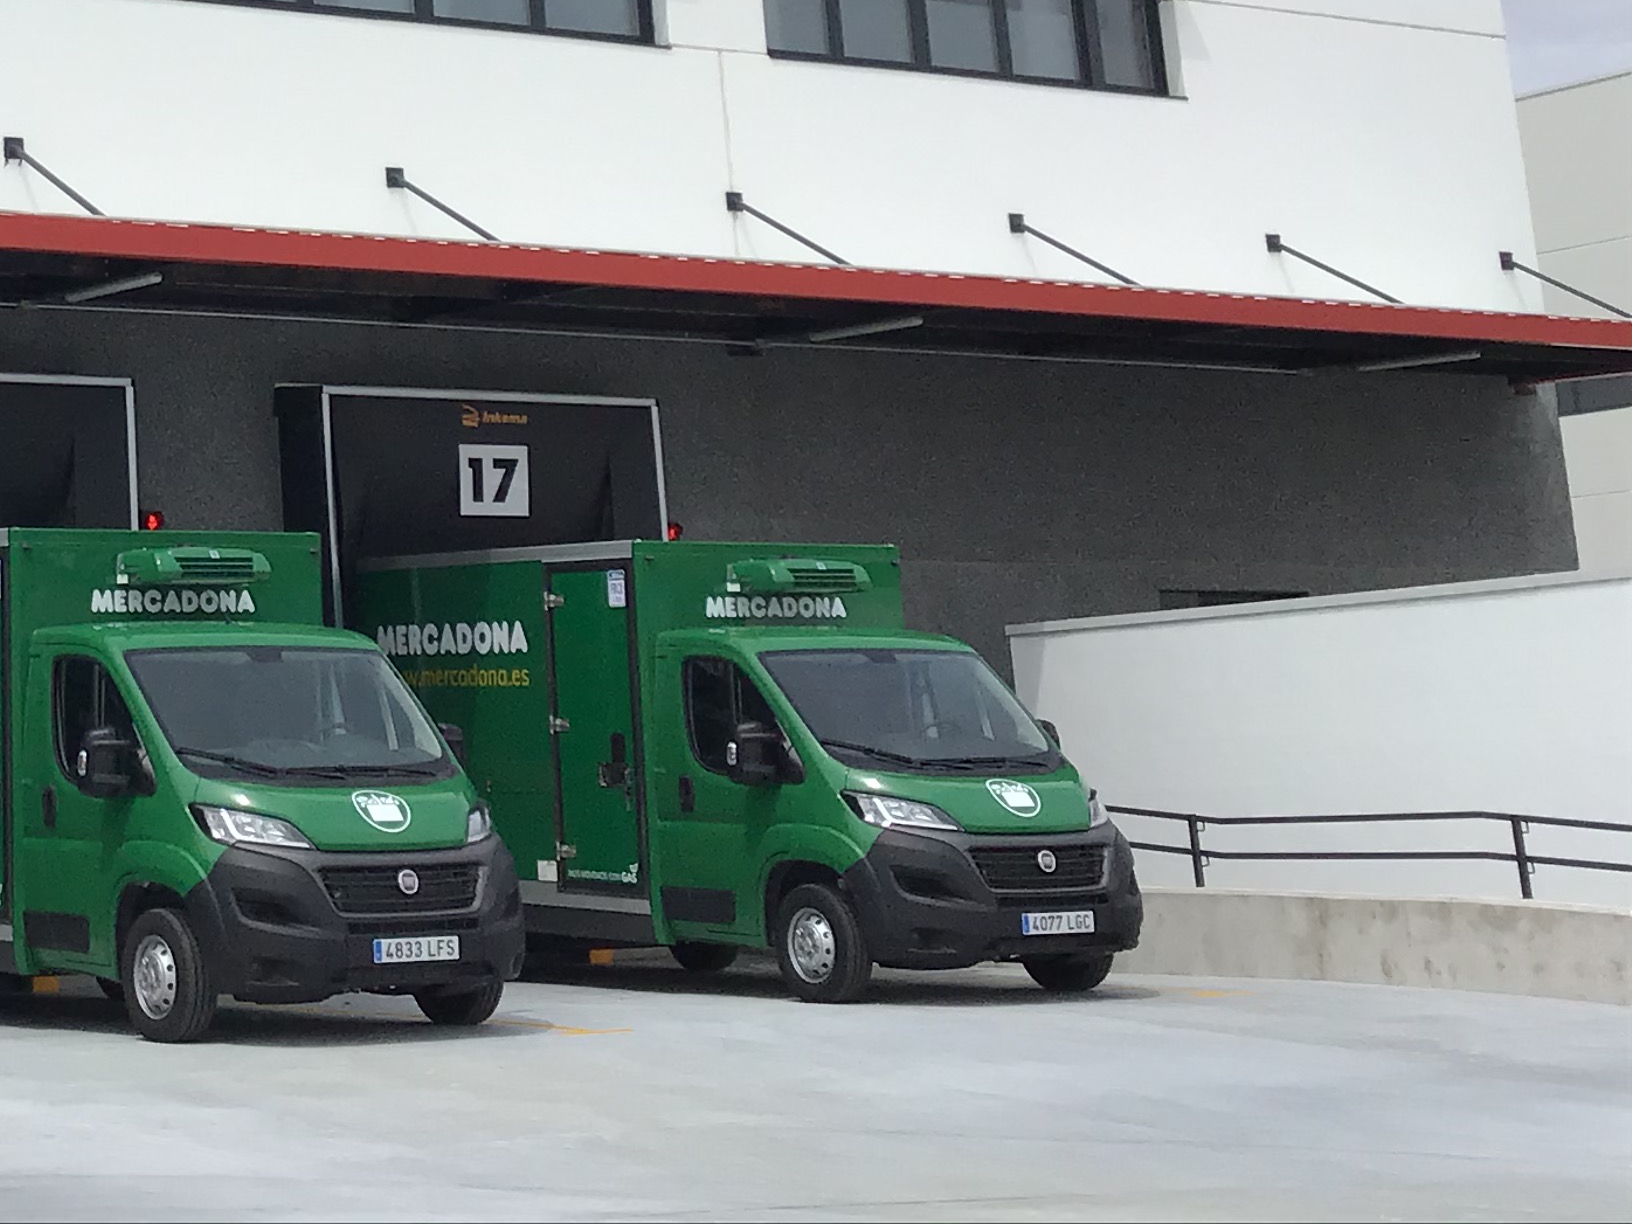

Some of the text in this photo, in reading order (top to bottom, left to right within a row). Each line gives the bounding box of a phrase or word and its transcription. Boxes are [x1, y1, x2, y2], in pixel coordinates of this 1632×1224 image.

[468, 457, 519, 504] 17
[91, 588, 256, 614] MERCADONA
[705, 595, 847, 618] MERCADONA
[376, 620, 529, 656] MERCADONA
[1032, 914, 1090, 931] 4077 LGC
[386, 939, 455, 959] 4833 LFS
